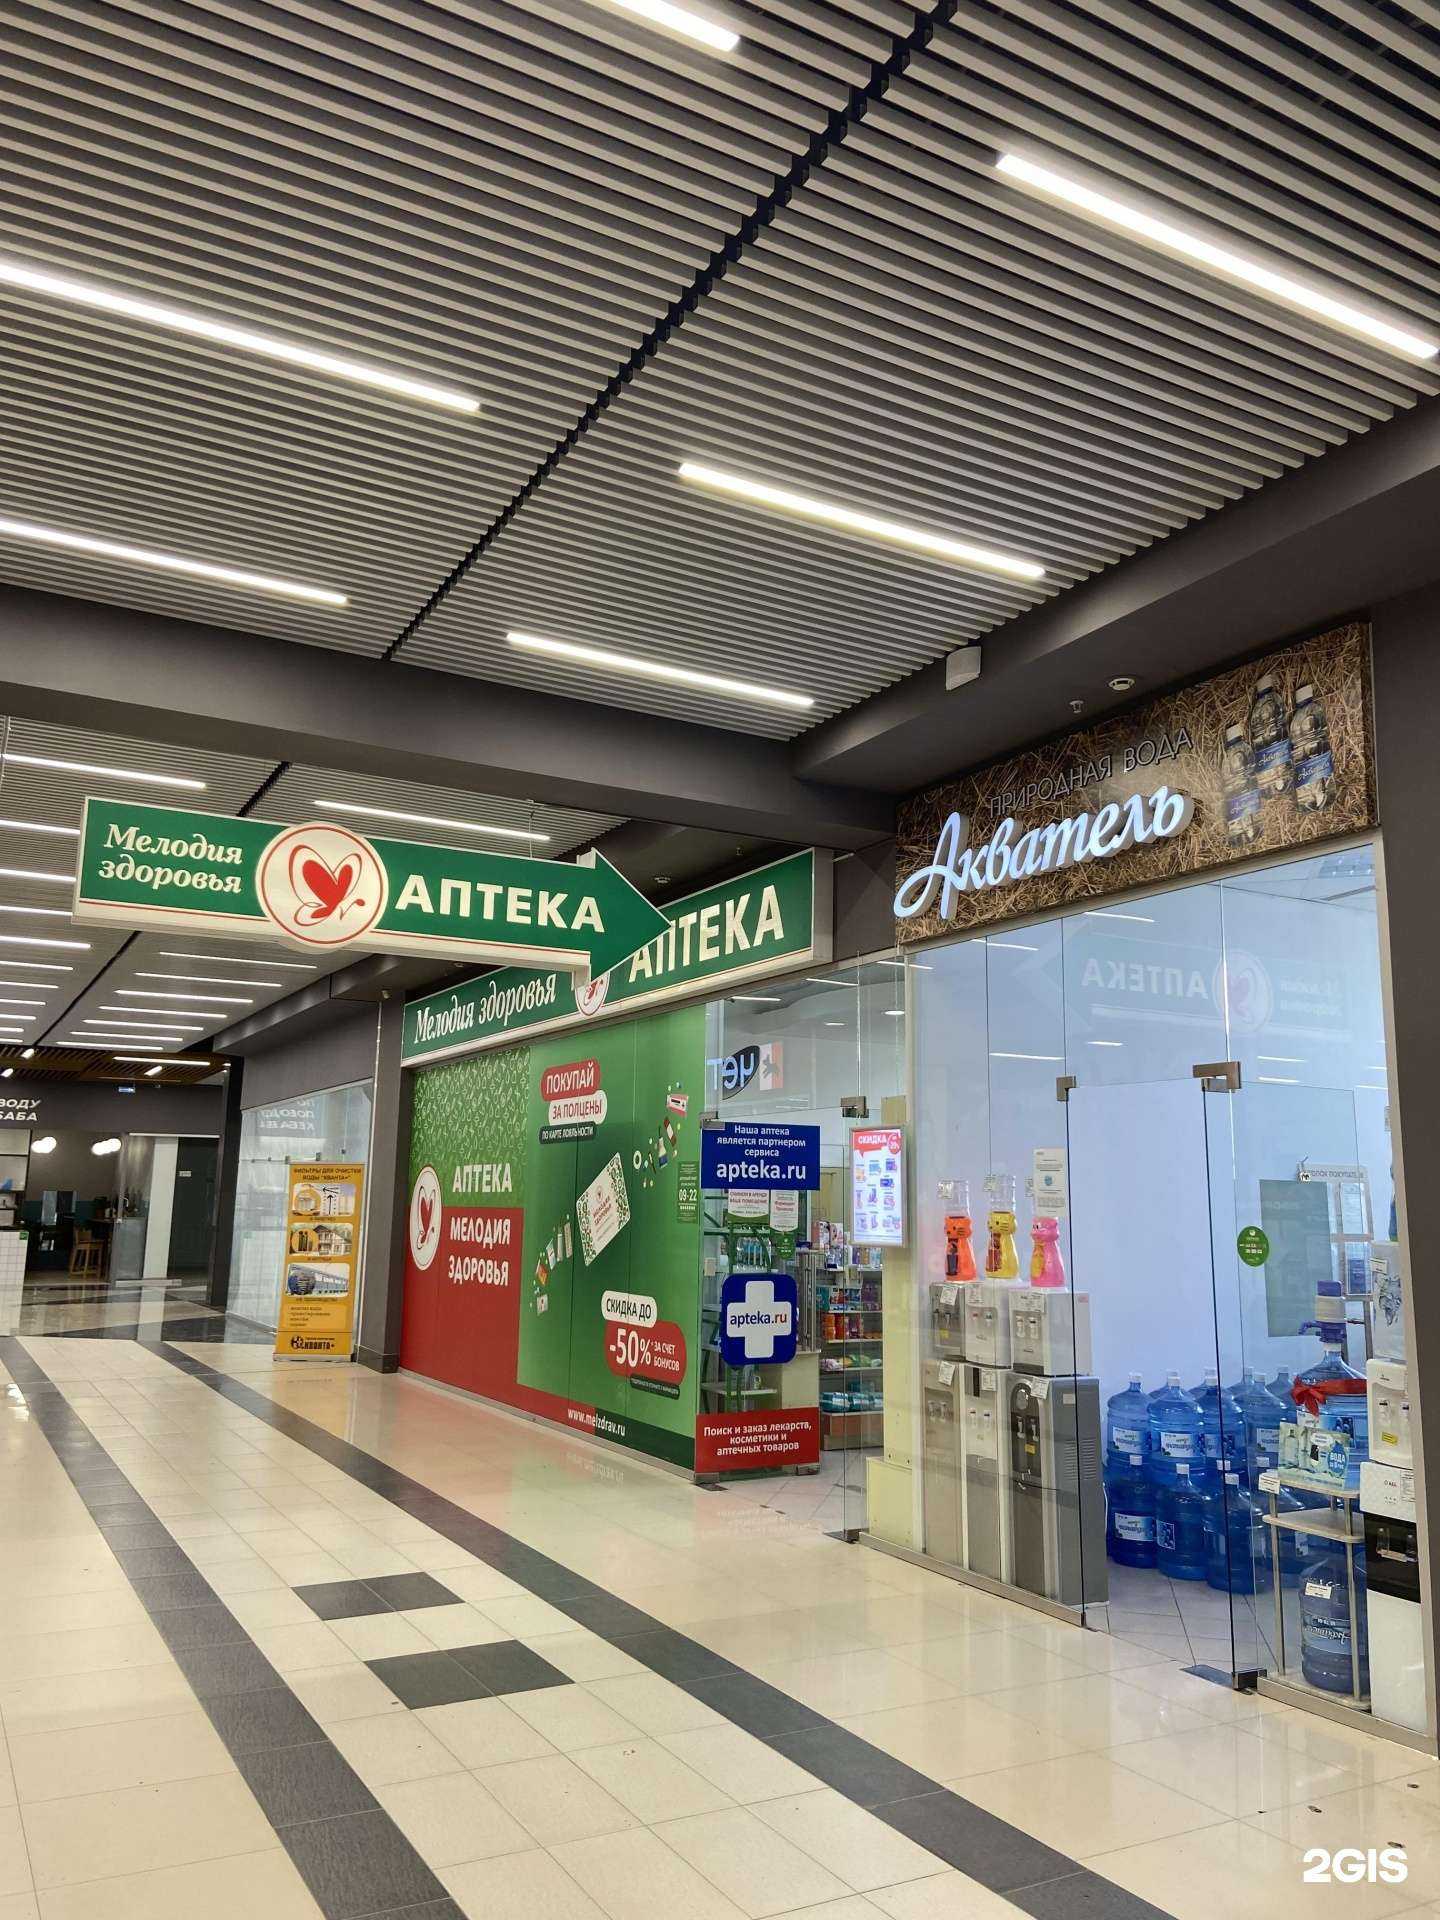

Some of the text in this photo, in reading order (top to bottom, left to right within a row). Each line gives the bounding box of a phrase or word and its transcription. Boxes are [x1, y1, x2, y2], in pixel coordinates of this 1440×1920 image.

[989, 726, 1195, 819] ПРИРОДНАЯ ВОДА
[102, 823, 244, 865] Мелодия
[893, 785, 1190, 920] Акватель
[98, 853, 243, 894] здоровья
[395, 873, 605, 934] АПТЕКА
[628, 884, 785, 983] АПТЕКА
[413, 972, 557, 1045] Мелодия здоровья
[546, 1061, 595, 1095] ПОКУПАЙ
[552, 1099, 602, 1120] ЗА ПОЛЦЕНЫ
[716, 1137, 806, 1148] является партнером
[734, 1125, 790, 1136] Наша аптека
[744, 1148, 780, 1158] сервиса
[452, 1162, 513, 1193] АПТЕКА
[716, 1159, 807, 1182] apteka.ru
[449, 1216, 511, 1250] МЕЛОДИЯ
[448, 1254, 509, 1287] ЗДОРОВЬЯ
[606, 1298, 652, 1322] СКИДКА ДО
[729, 1310, 788, 1328] apteka.ru
[654, 1340, 676, 1355] ЗА СЧЕТ
[653, 1355, 680, 1372] БОНУСОВ
[567, 1408, 626, 1437] www.melzdrav.ru
[703, 1426, 733, 1437] Поиск
[734, 1425, 741, 1434] и
[743, 1423, 768, 1434] заказ
[716, 1441, 800, 1456] аптечных товаров
[729, 1432, 787, 1445] косметики и
